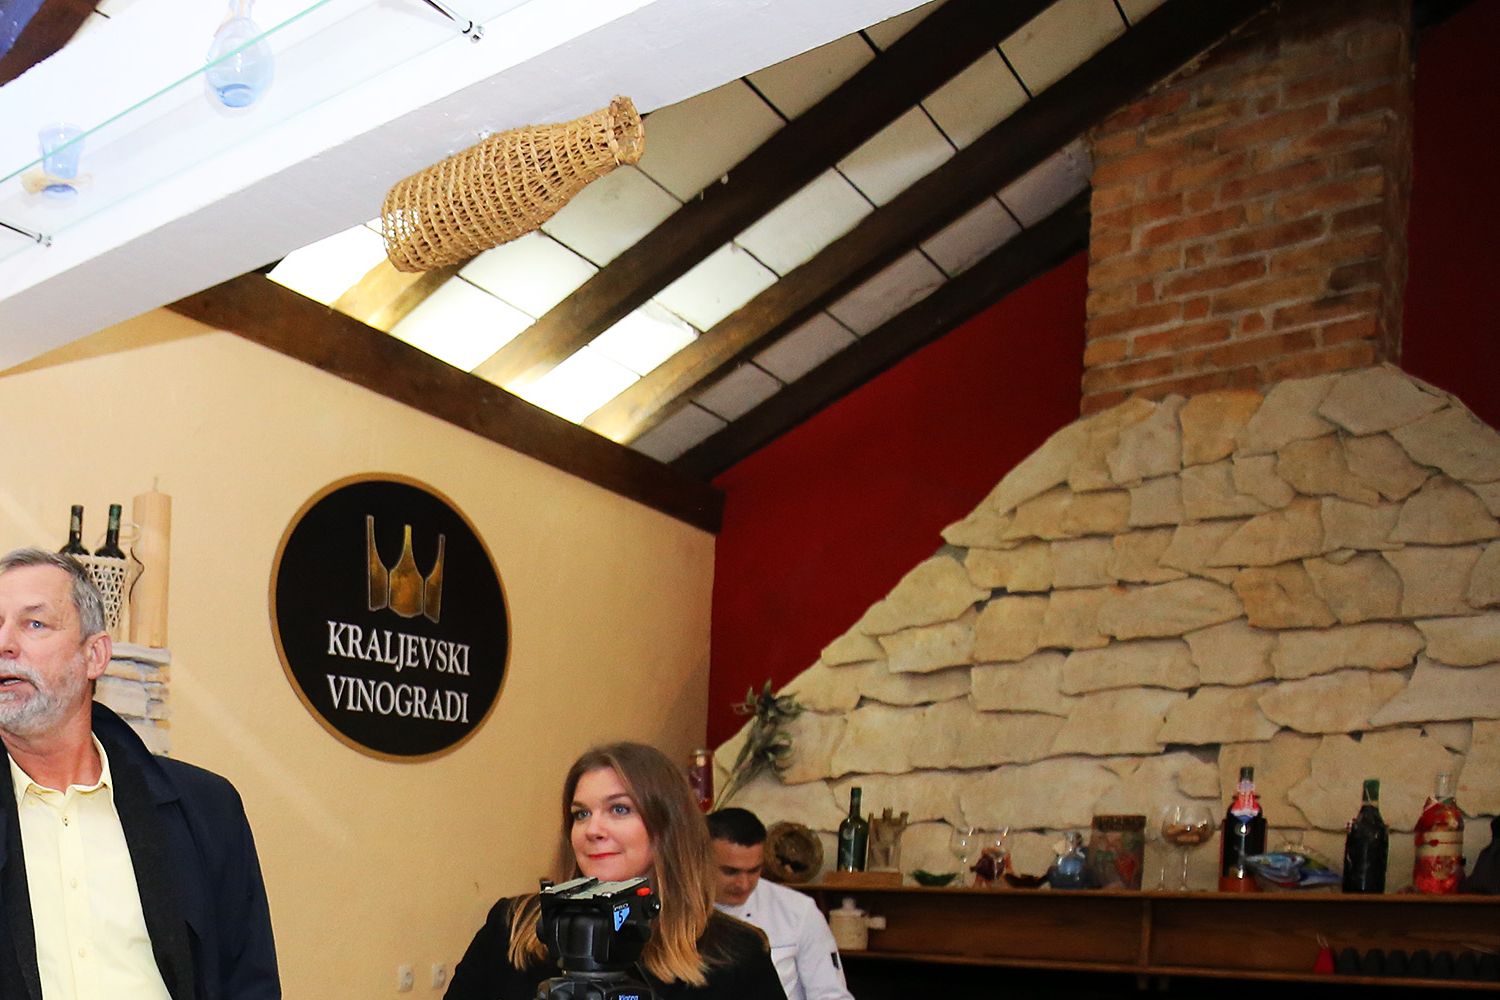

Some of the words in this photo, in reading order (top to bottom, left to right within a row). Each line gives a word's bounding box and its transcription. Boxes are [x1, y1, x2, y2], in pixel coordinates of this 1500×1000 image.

[326, 620, 470, 676] KRALJEVSKI
[326, 674, 469, 723] VINOGRADI
[618, 911, 623, 924] 5
